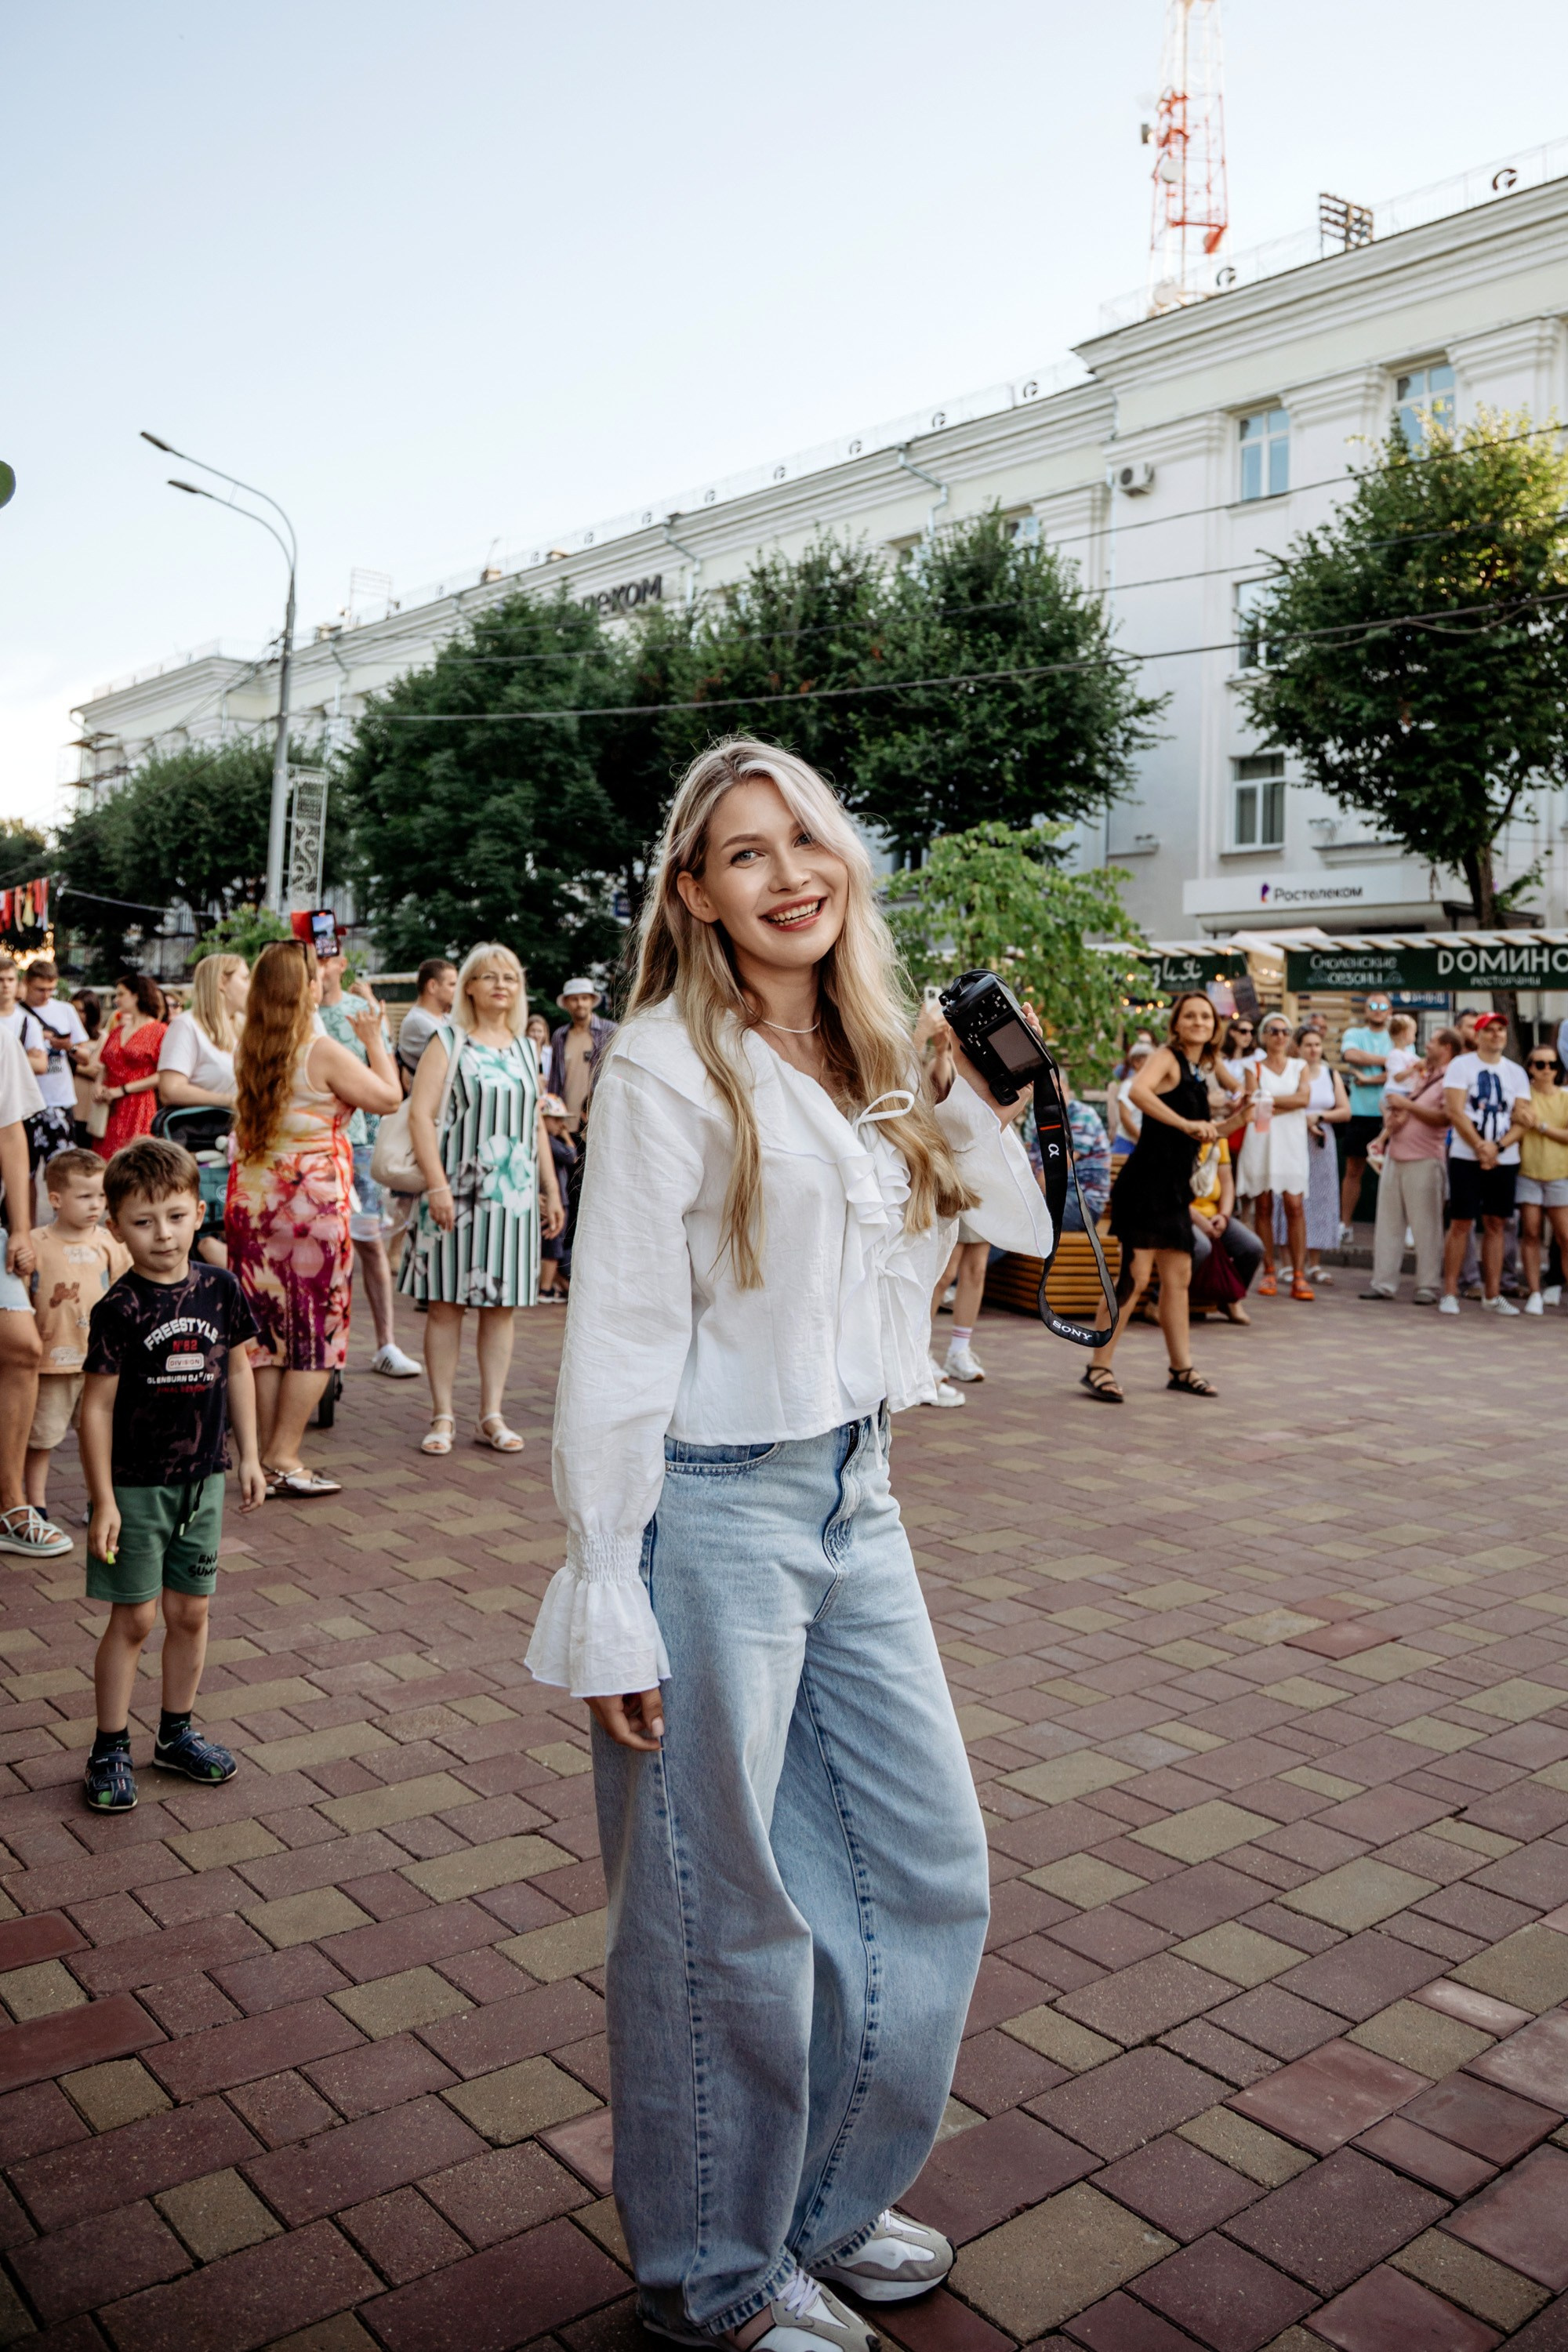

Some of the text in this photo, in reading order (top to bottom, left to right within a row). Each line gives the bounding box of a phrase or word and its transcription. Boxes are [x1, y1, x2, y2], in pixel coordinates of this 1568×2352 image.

[1275, 887, 1363, 902] Ростелеком
[1309, 953, 1397, 969] Смоленские
[1327, 971, 1383, 985] сезоны
[1470, 975, 1541, 985] рестораны
[143, 1317, 219, 1351] FREESTYLE
[1052, 1319, 1093, 1341] SONY
[147, 1374, 187, 1385] GLENBURN
